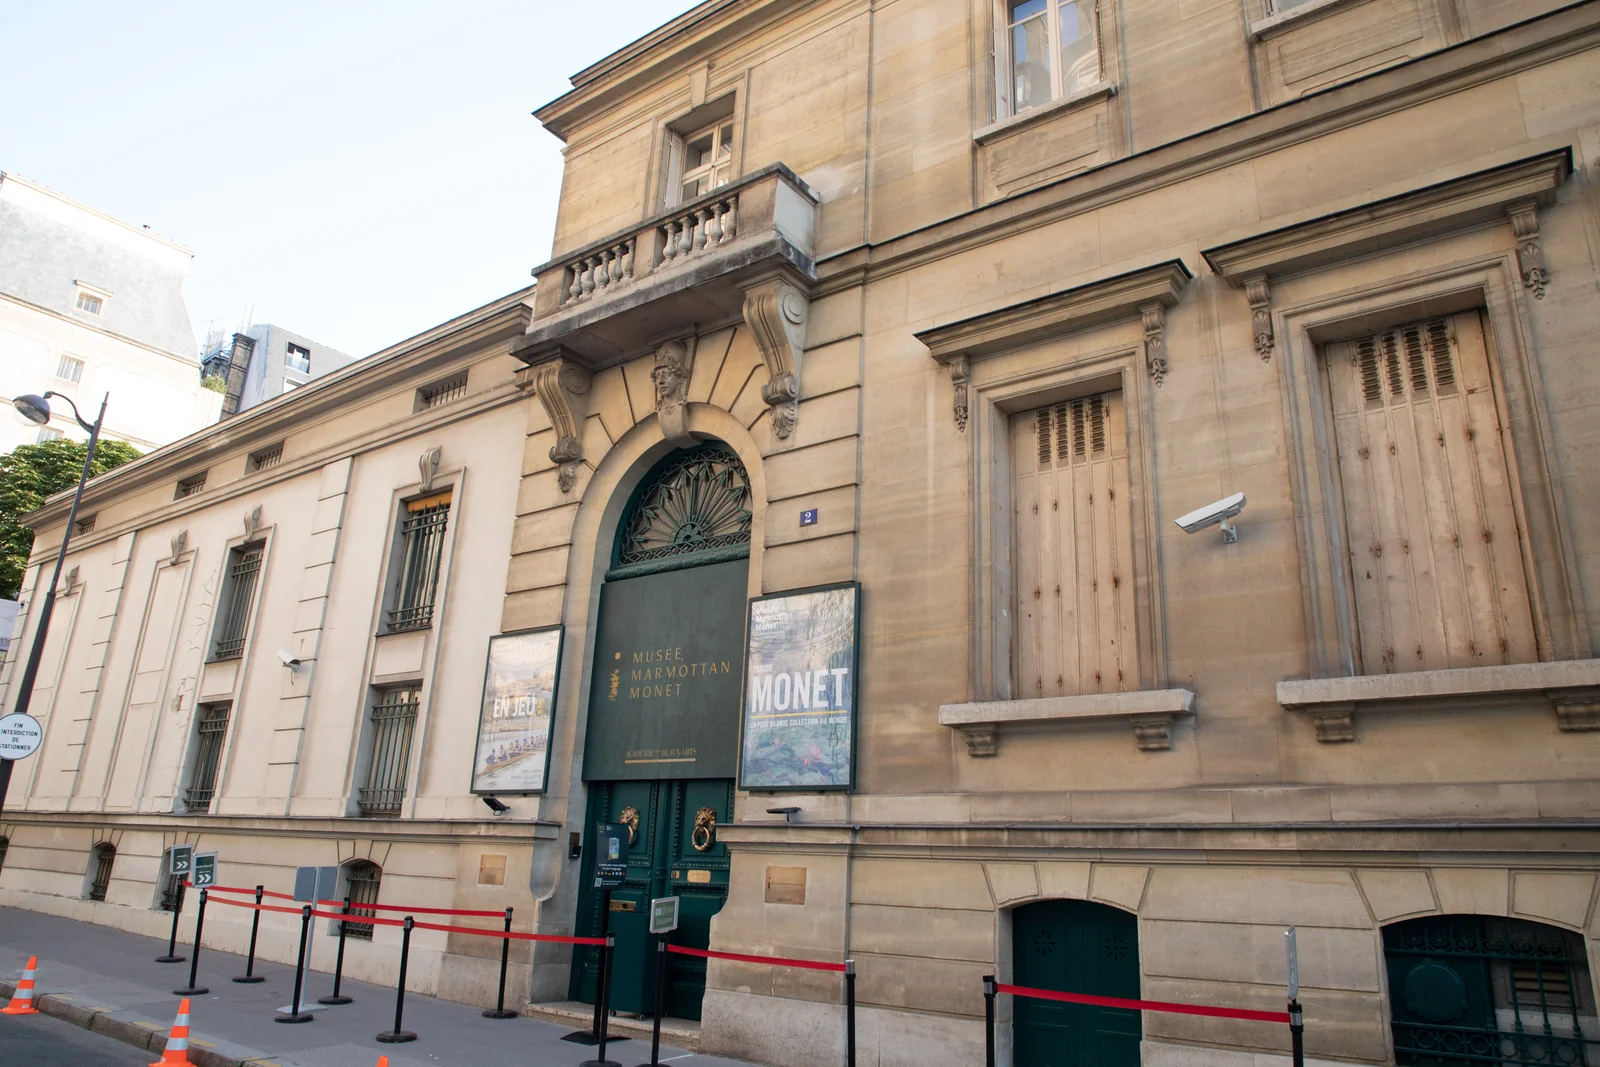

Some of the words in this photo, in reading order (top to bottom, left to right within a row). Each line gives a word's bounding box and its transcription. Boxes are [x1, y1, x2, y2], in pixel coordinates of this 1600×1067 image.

[804, 511, 812, 524] 2
[631, 661, 730, 681] MARMOTTAN
[629, 683, 682, 699] MONET
[751, 667, 848, 713] MONET
[493, 698, 510, 718] EN
[512, 696, 536, 716] JEU
[757, 720, 769, 728] PLUS
[769, 719, 789, 728] GRANDE
[789, 717, 819, 726] COLLECTION
[661, 747, 697, 757] BEAUX-ARTS
